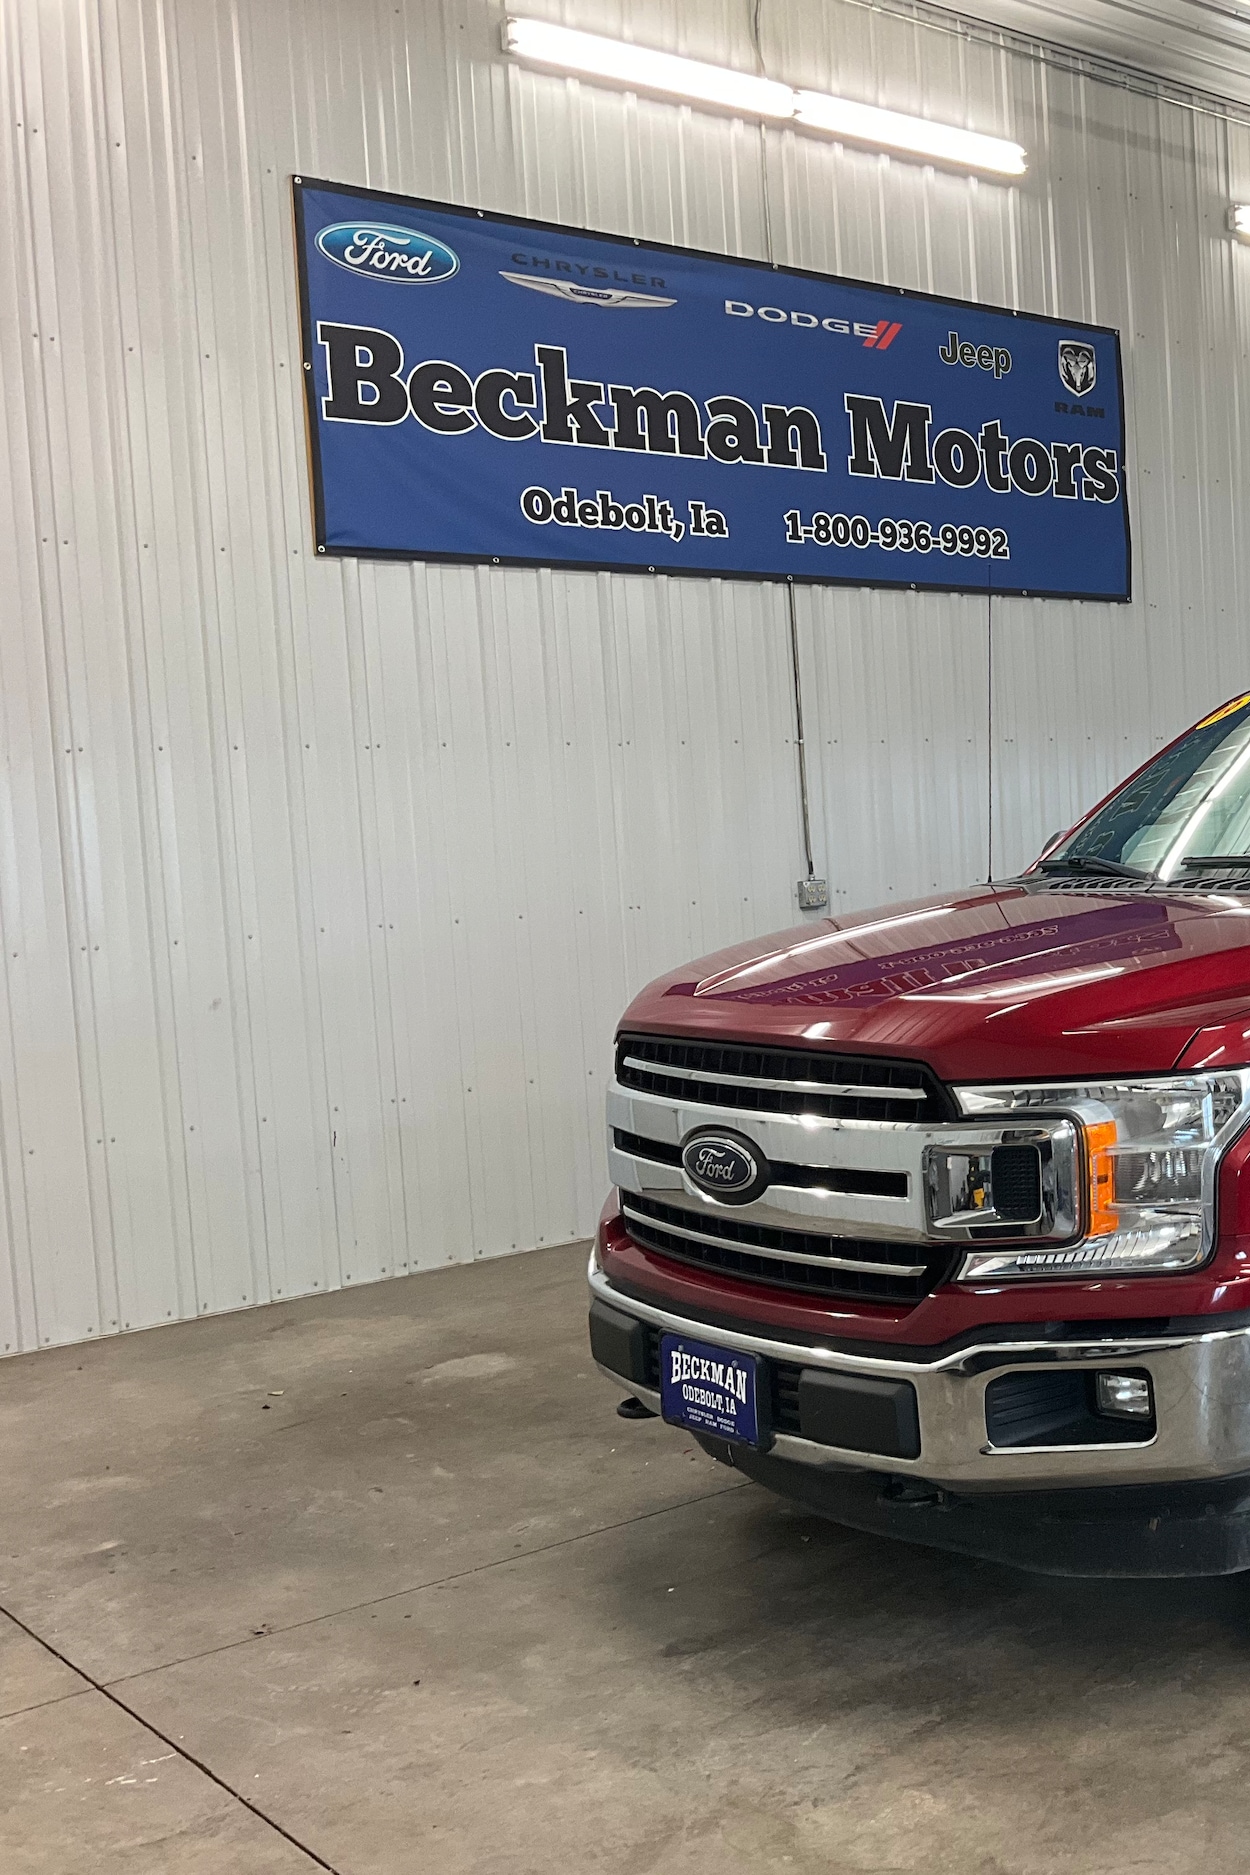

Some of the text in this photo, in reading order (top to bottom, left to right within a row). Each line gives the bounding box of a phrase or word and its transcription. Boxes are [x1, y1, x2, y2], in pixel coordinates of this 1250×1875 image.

[343, 228, 433, 278] Ford
[511, 252, 669, 290] CHRYSLER
[724, 300, 879, 338] DODGE
[938, 331, 1013, 379] Jeep
[316, 320, 1121, 504] Beckman Motors
[1054, 402, 1106, 419] RAM
[520, 486, 730, 543] Odebolt, Ia
[783, 509, 1011, 560] 1-800-936-9992
[695, 1147, 736, 1181] Ford
[670, 1350, 748, 1405] BECKMAN
